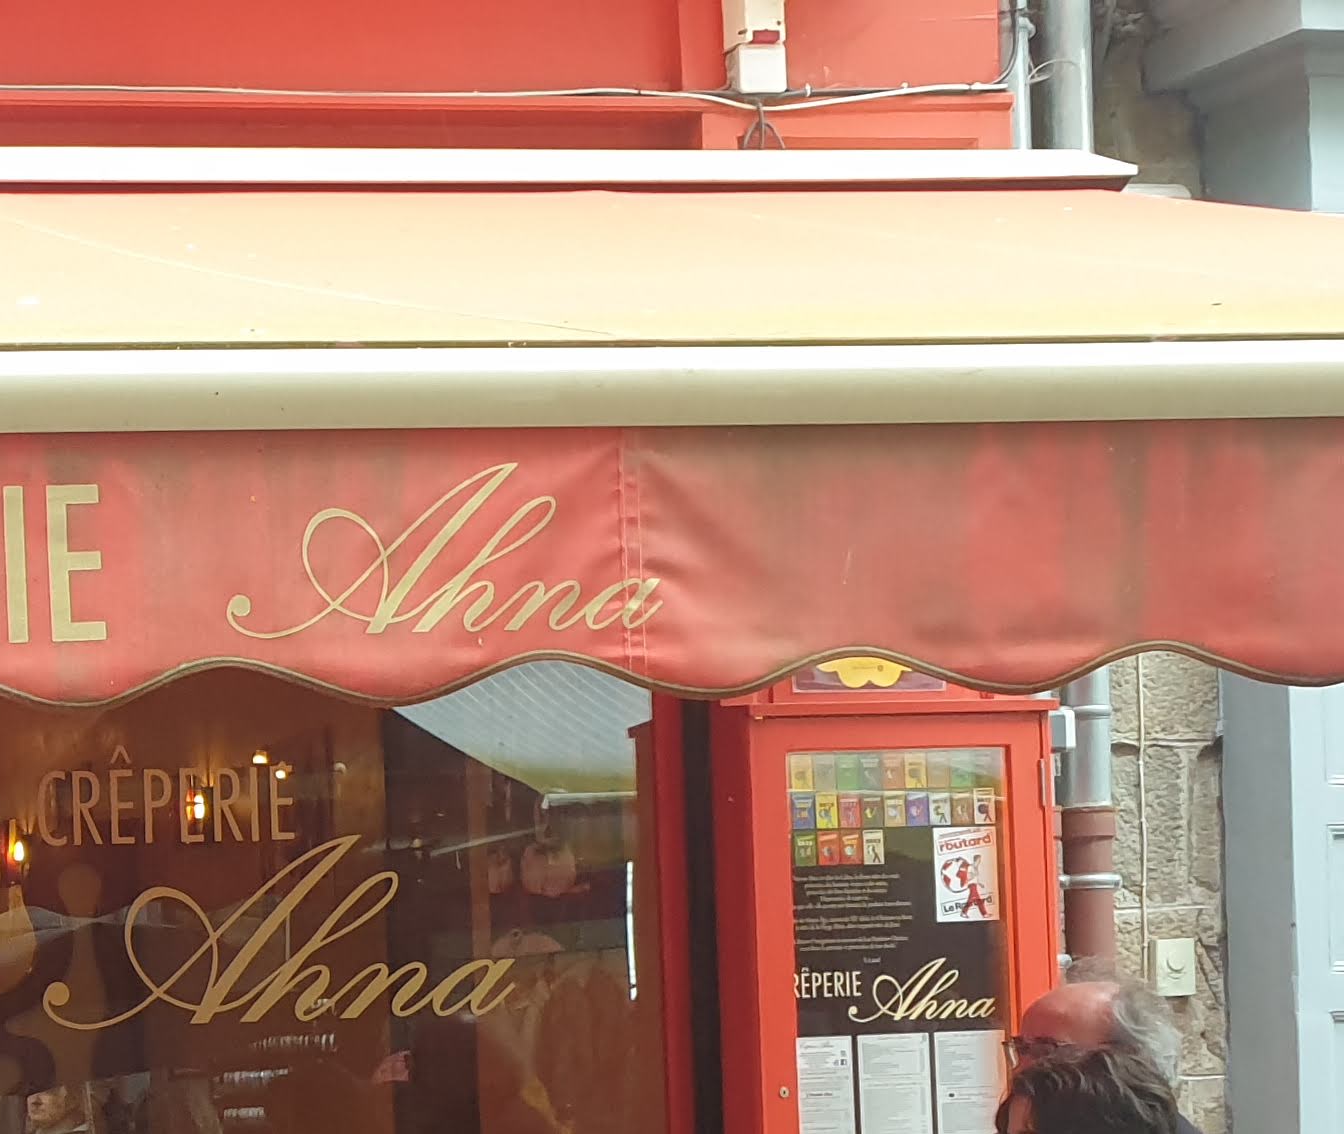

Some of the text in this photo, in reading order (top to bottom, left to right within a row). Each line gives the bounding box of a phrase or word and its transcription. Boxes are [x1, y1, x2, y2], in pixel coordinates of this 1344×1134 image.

[225, 463, 662, 640] Ahna
[37, 745, 296, 846] CRÊPERIE
[939, 834, 992, 852] routard
[42, 834, 516, 1030] Ahna
[793, 957, 995, 1023] RÊPERIE Ahna
